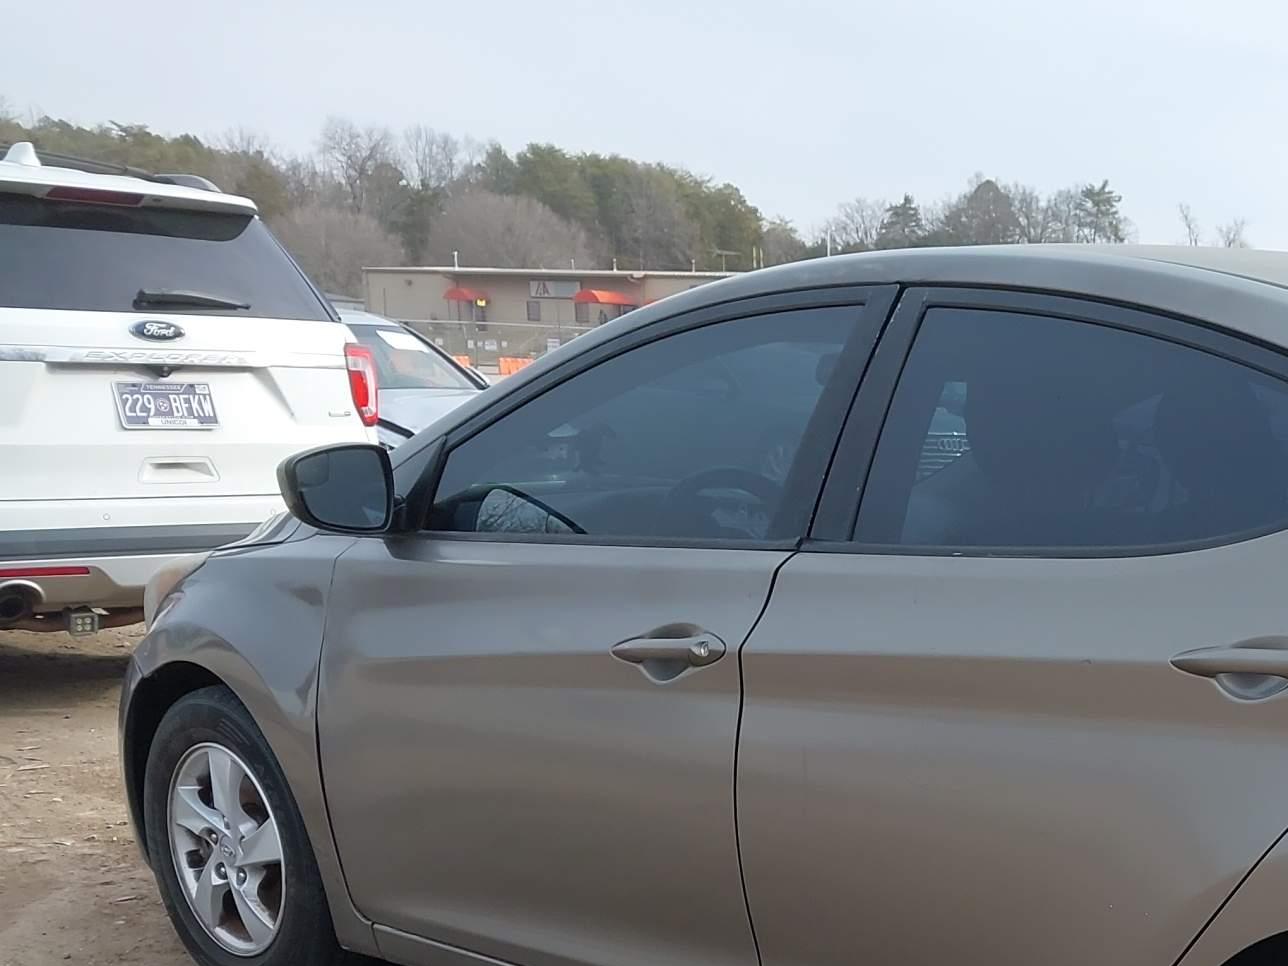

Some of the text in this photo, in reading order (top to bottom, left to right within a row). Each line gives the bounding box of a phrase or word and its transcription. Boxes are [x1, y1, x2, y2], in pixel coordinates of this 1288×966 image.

[144, 322, 175, 337] Ford
[84, 351, 248, 366] EXPLORER
[122, 394, 214, 417] 229 BFKW
